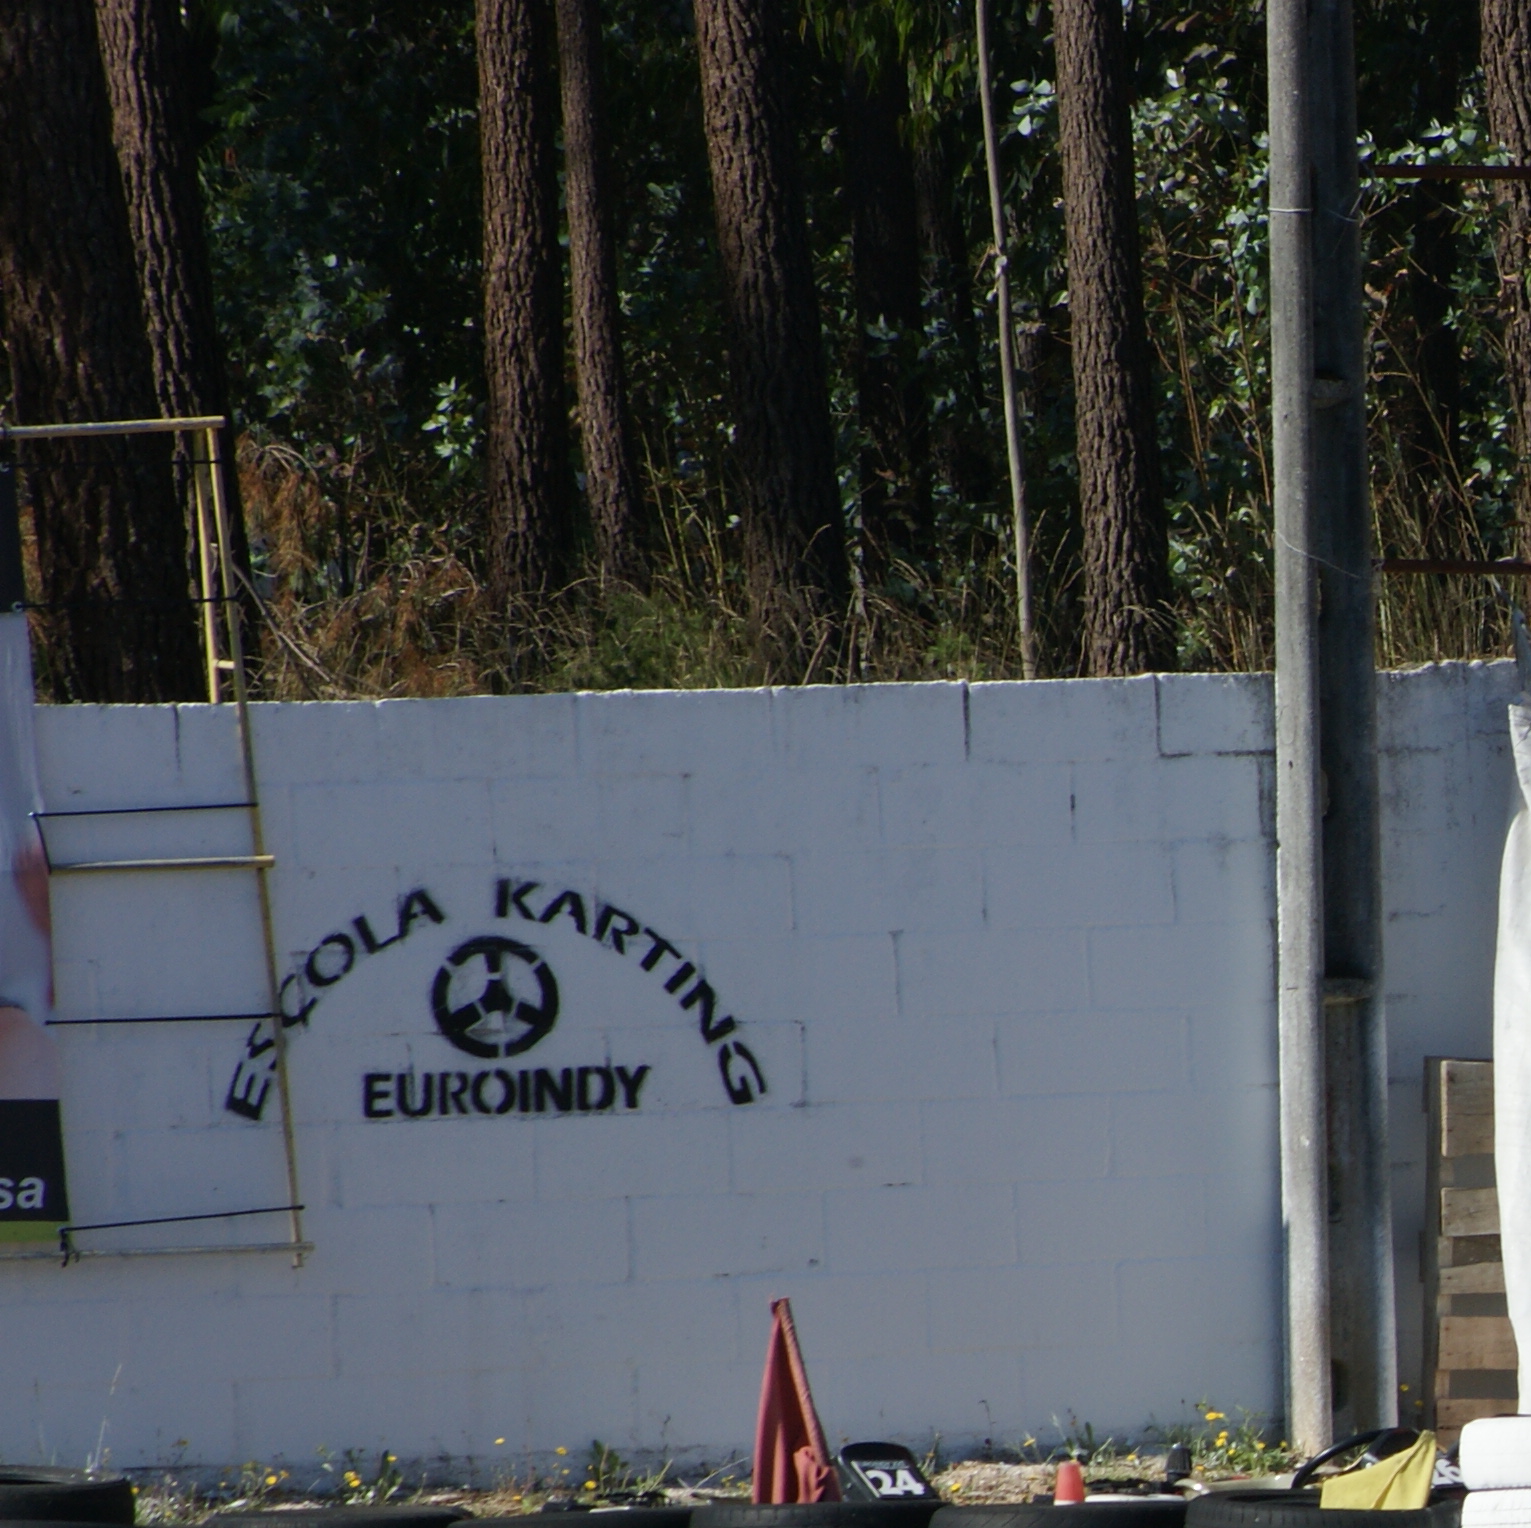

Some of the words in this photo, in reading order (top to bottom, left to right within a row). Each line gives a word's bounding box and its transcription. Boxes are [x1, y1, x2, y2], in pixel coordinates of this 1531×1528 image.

[495, 878, 768, 1104] KARTING
[362, 1063, 654, 1120] EUROINDY
[864, 1469, 925, 1496] 24
